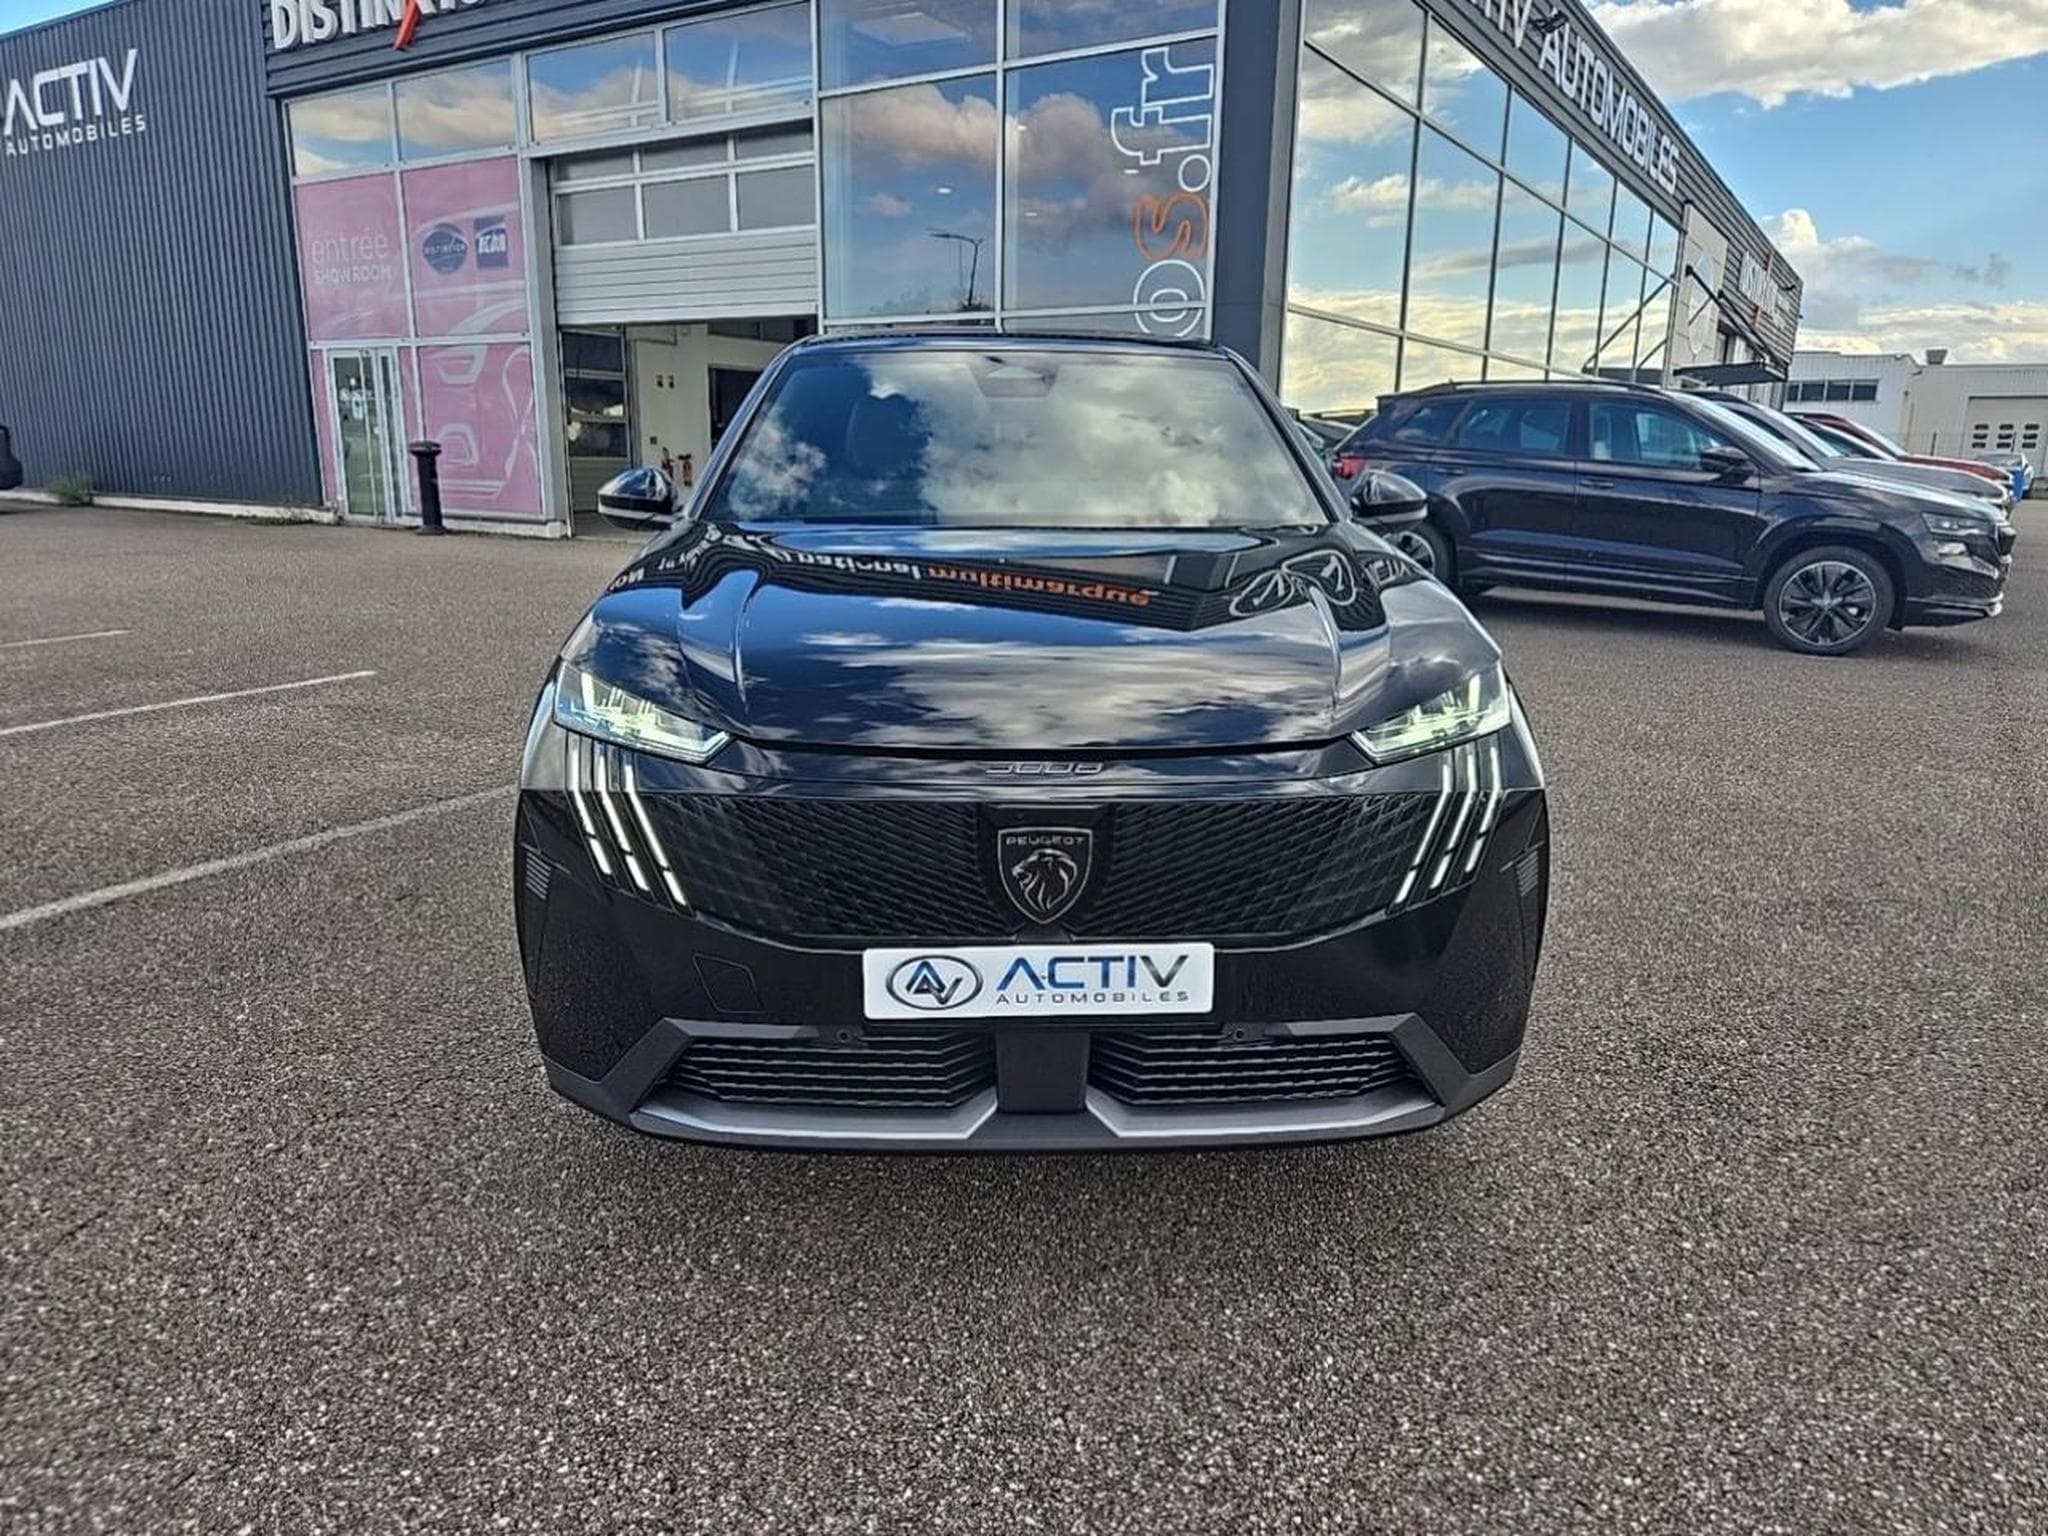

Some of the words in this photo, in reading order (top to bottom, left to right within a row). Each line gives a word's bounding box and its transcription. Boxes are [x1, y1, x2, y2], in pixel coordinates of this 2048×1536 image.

[4, 48, 137, 136] ACTIV
[1538, 7, 1679, 195] AUTOMOBILES
[6, 114, 146, 157] AUTOMOBILES
[311, 227, 389, 264] entrée
[314, 264, 394, 285] SHOWROOM
[1006, 835, 1086, 846] PEUGEOT
[996, 954, 1190, 992] ACTIV
[996, 990, 1190, 1005] AUTOMOBILES
